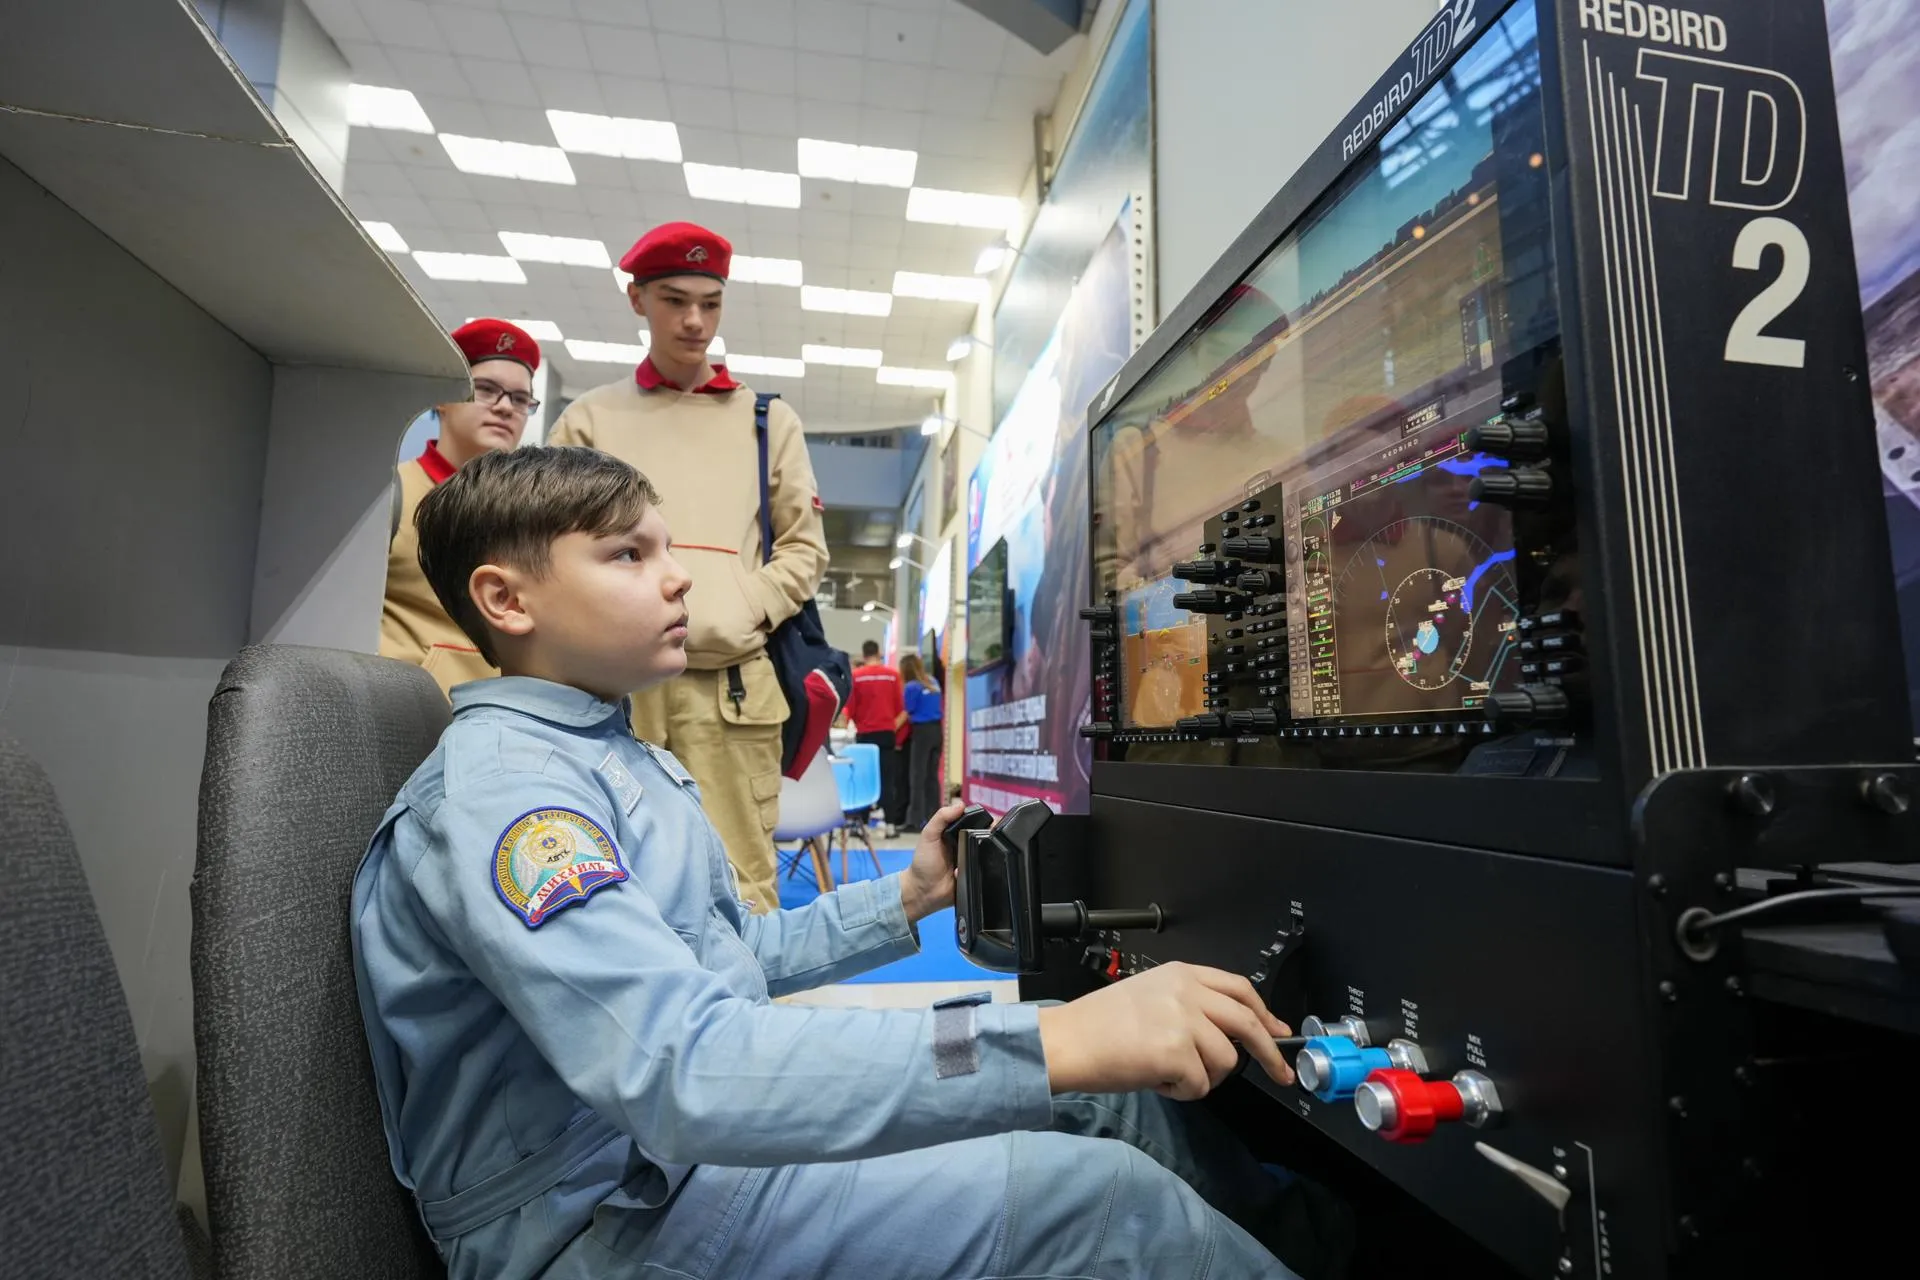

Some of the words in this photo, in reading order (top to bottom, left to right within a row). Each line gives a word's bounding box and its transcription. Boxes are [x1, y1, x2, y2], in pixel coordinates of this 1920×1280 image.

[1579, 0, 1727, 52] REDBIRD
[1342, 72, 1413, 161] REDBIRD
[1635, 47, 1806, 211] TD
[1724, 216, 1811, 368] 2
[1382, 438, 1419, 460] REDBIRD
[546, 849, 571, 863] АВТК
[1347, 985, 1364, 998] THROT
[1349, 995, 1364, 1006] PUSH
[1401, 998, 1418, 1010] PROP
[1350, 1004, 1364, 1016] OPEN
[1401, 1008, 1419, 1021] PUSH
[1404, 1027, 1419, 1040] RPM
[1468, 1033, 1482, 1046] MIX
[1466, 1043, 1485, 1058] PULL
[1467, 1053, 1487, 1068] LEAN
